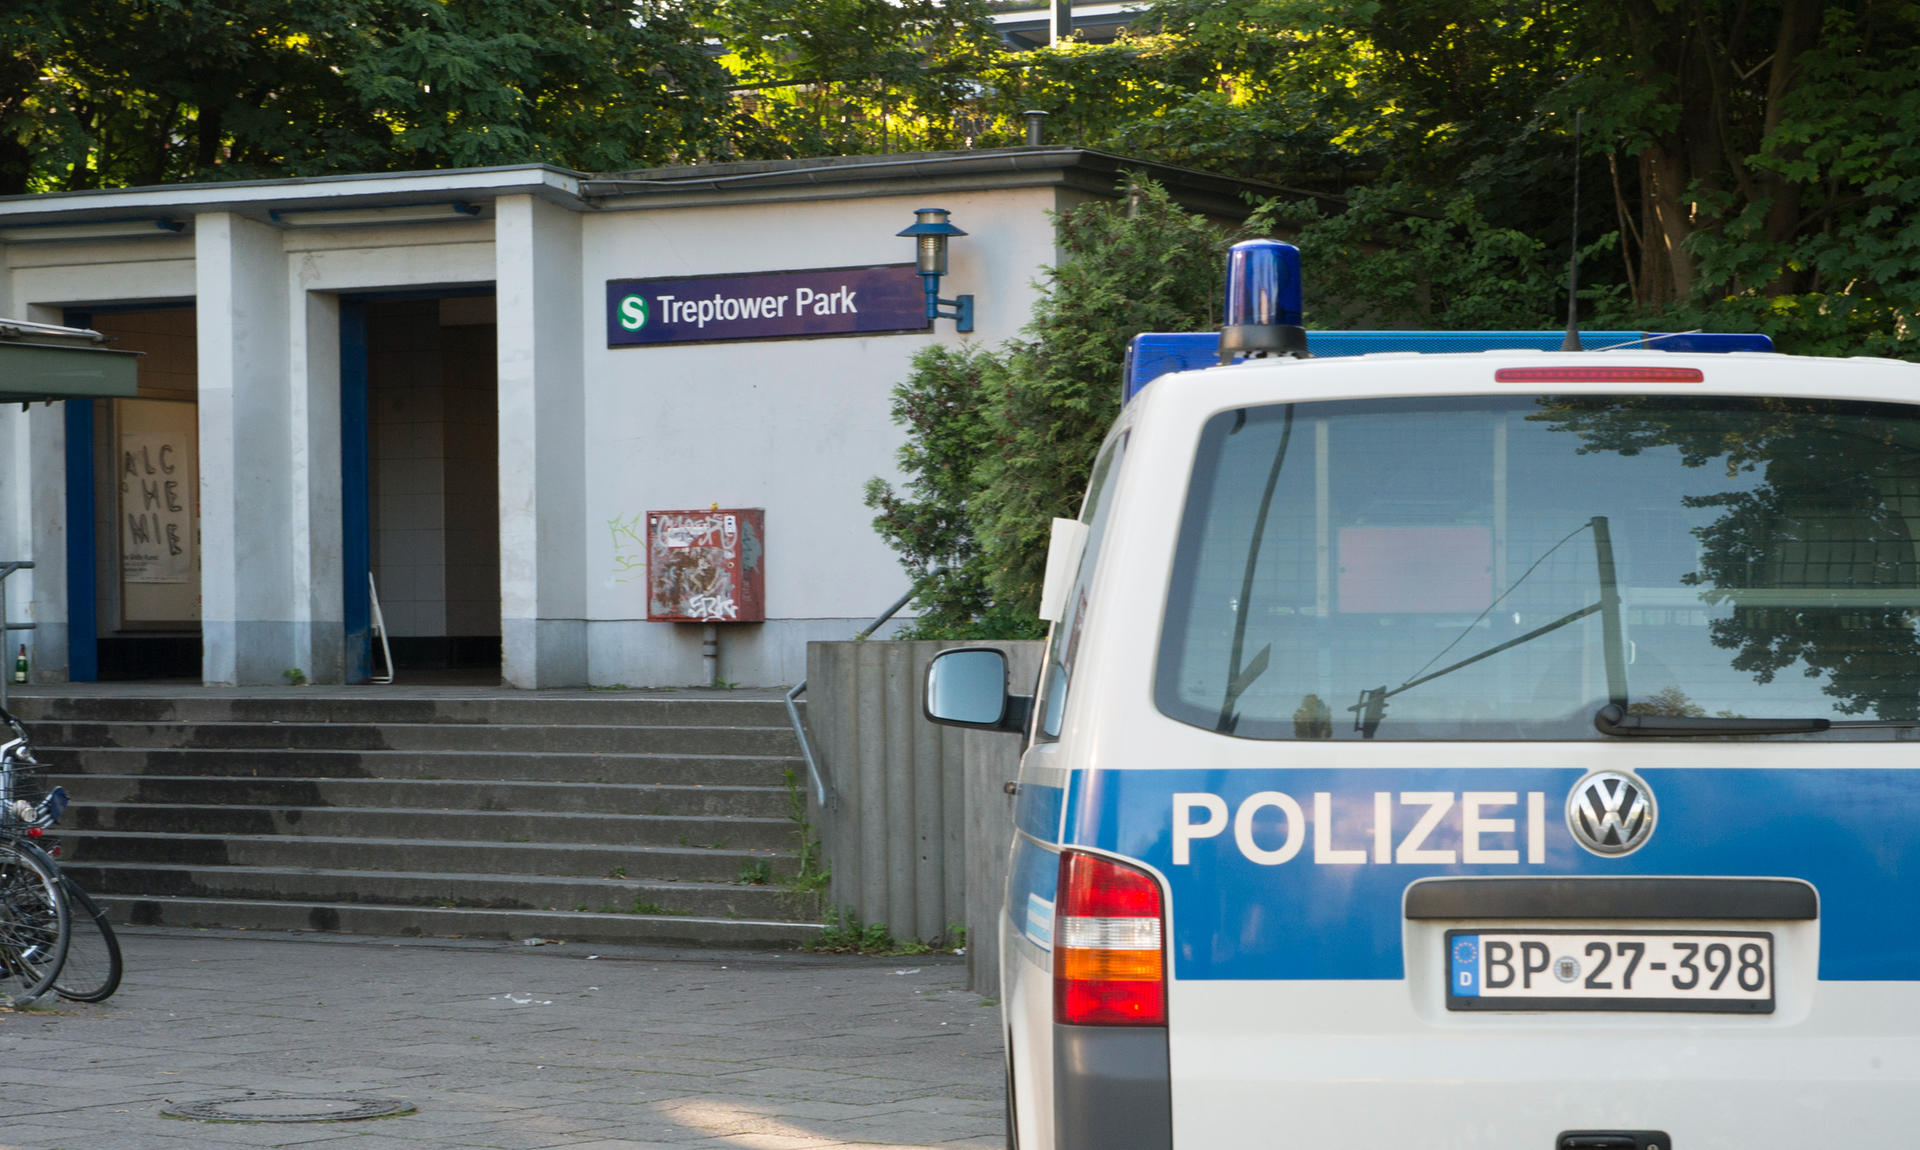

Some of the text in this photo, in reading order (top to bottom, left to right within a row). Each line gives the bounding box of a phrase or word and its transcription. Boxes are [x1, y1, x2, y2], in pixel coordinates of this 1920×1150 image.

[621, 285, 857, 329] S Treptower Park
[124, 444, 175, 477] ALC
[1172, 790, 1545, 866] POLIZEI
[1573, 774, 1652, 851] VW
[1460, 971, 1472, 986] D
[1485, 941, 1765, 991] BP 27-398
